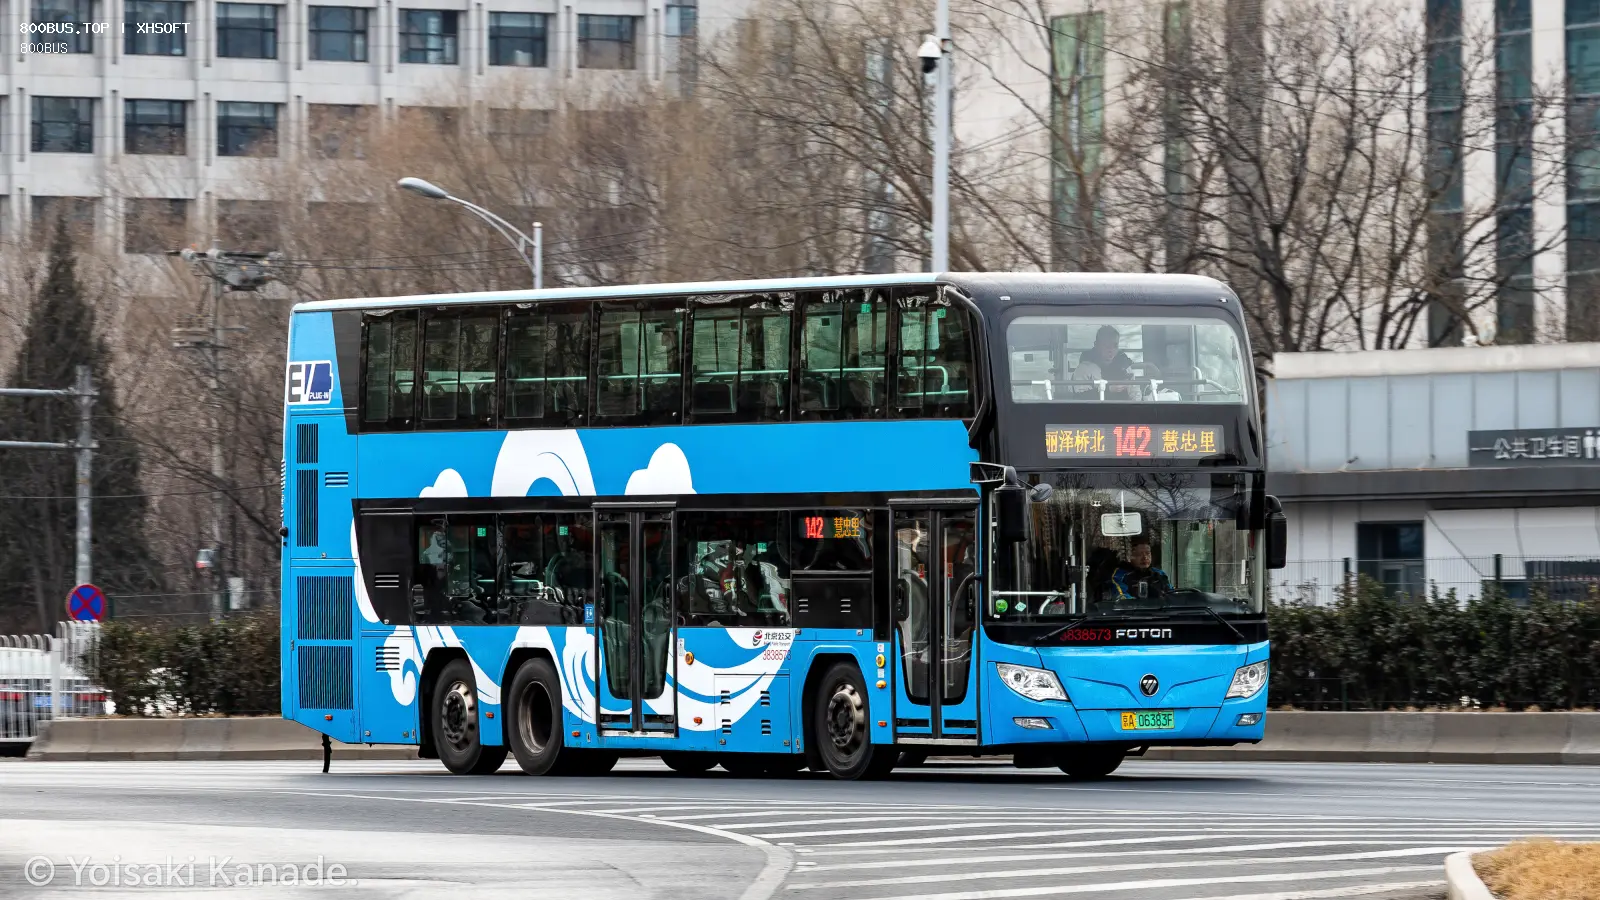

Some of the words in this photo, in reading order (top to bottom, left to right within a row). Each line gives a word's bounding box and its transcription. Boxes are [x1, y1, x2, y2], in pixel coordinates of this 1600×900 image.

[309, 391, 330, 400] PLUG-IN
[1113, 426, 1152, 457] 142
[1162, 429, 1217, 453] 慧忠里
[804, 516, 825, 539] 142
[834, 516, 860, 539] 慧忠里
[764, 632, 792, 641] 北京公交
[1115, 628, 1172, 639] FOTON
[762, 649, 792, 661] 3838573
[1138, 713, 1173, 727] 06383F
